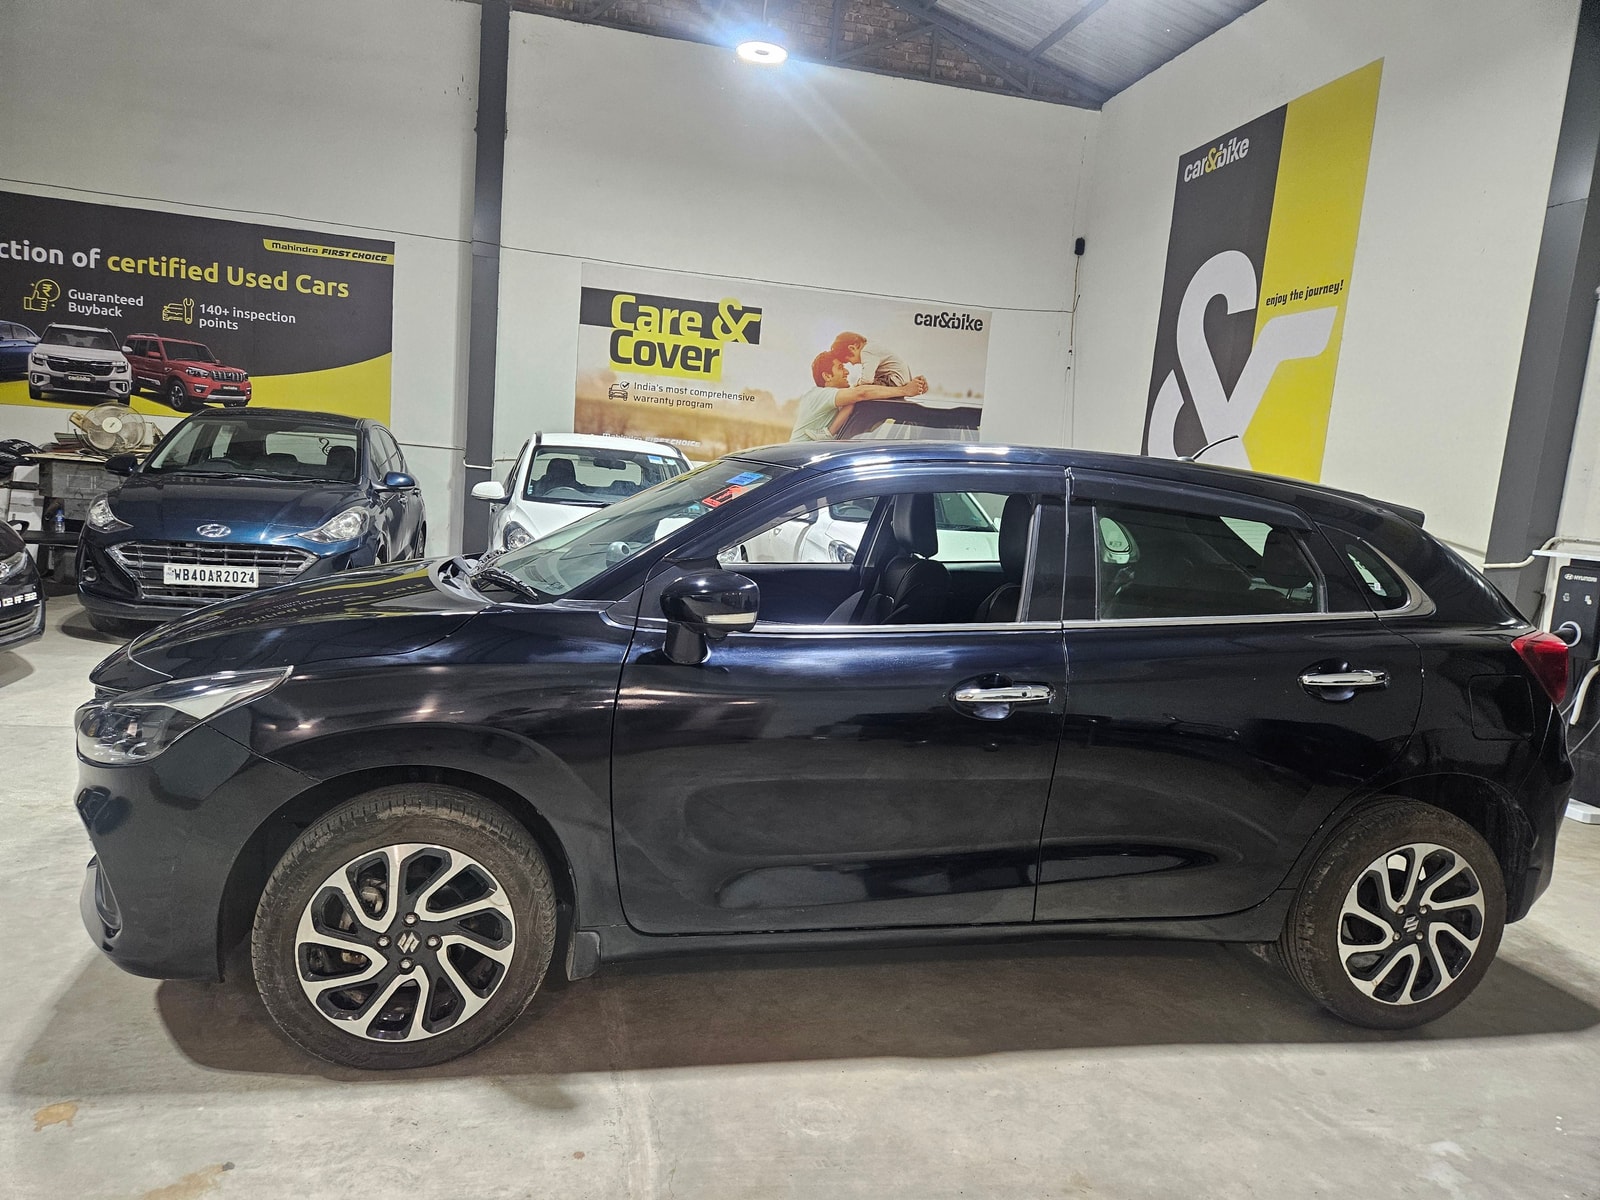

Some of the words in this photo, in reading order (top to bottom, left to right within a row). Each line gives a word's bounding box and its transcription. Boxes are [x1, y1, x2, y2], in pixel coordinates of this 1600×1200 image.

[1183, 137, 1250, 183] car&bike
[271, 242, 318, 254] Mahindra
[321, 248, 351, 257] FIRST
[351, 252, 388, 262] CHOICE
[71, 248, 101, 269] of
[107, 255, 219, 283] certified
[226, 265, 288, 291] Used
[295, 274, 349, 298] Cars
[68, 289, 144, 307] Guaranteed
[1265, 293, 1288, 307] enjoy
[1289, 289, 1304, 301] the
[1304, 279, 1344, 301] journey!
[68, 302, 123, 318] Buyback
[199, 303, 230, 317] 140+
[232, 307, 296, 324] inspection
[612, 294, 702, 337] Care
[711, 297, 762, 345] &
[199, 318, 239, 330] points
[914, 312, 984, 331] car&bike
[610, 329, 720, 373] Cover
[634, 382, 663, 391] India's
[665, 387, 688, 395] most
[689, 388, 756, 402] comprehensive
[633, 395, 674, 407] warranty
[676, 398, 713, 410] program
[174, 567, 255, 584] WB40AR2024
